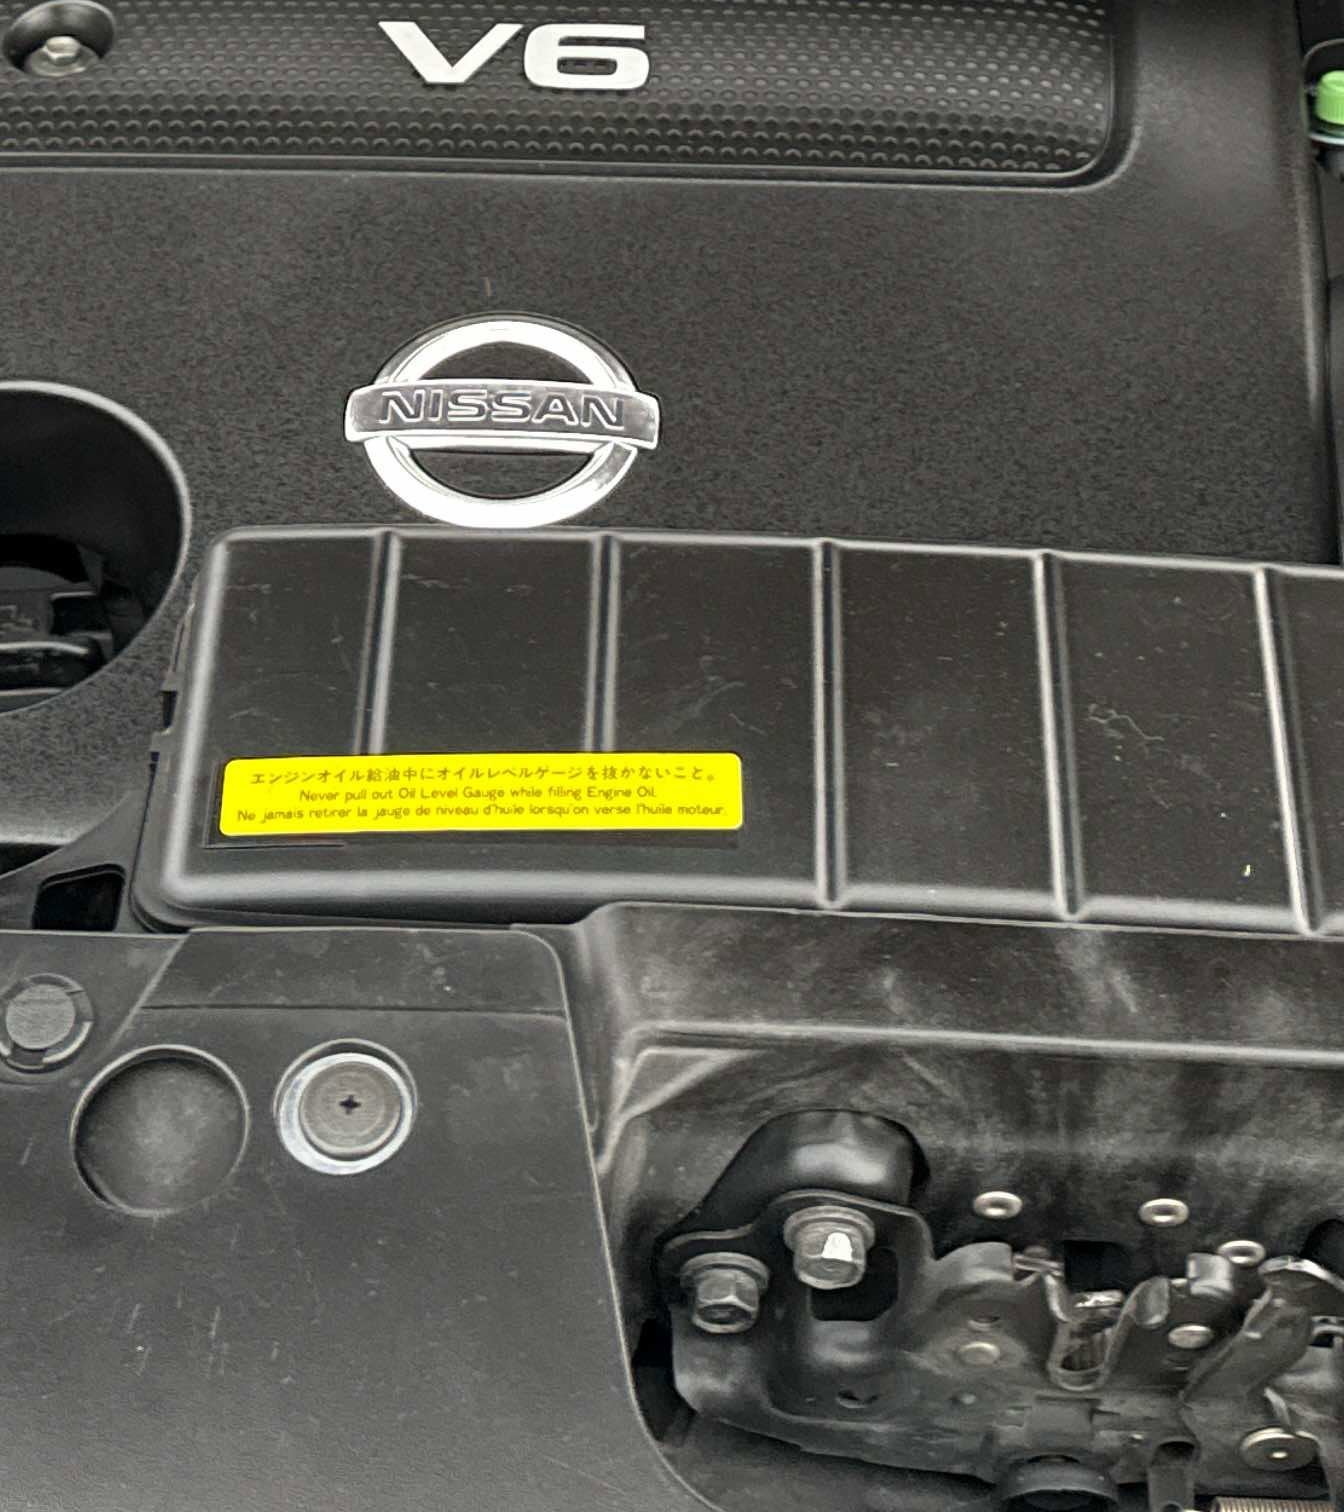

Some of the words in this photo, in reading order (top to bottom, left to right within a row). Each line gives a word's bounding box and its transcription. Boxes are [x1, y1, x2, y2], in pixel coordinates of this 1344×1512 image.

[377, 21, 650, 90] V6
[379, 390, 625, 429] NISSAN
[299, 789, 339, 801] Never
[344, 789, 367, 803] pull
[371, 789, 394, 800] out
[398, 787, 416, 799] Oil
[420, 787, 458, 799] Level
[462, 786, 505, 801] Gauge
[510, 786, 543, 798] while
[548, 785, 582, 801] filling
[586, 786, 632, 800] Engine
[237, 809, 256, 822] Ne
[261, 809, 304, 824] jamais
[309, 807, 352, 819] retirer
[356, 806, 368, 817] la
[373, 805, 410, 820] jauge
[415, 804, 431, 816] de
[436, 805, 479, 816] niveau
[594, 804, 631, 815] verse
